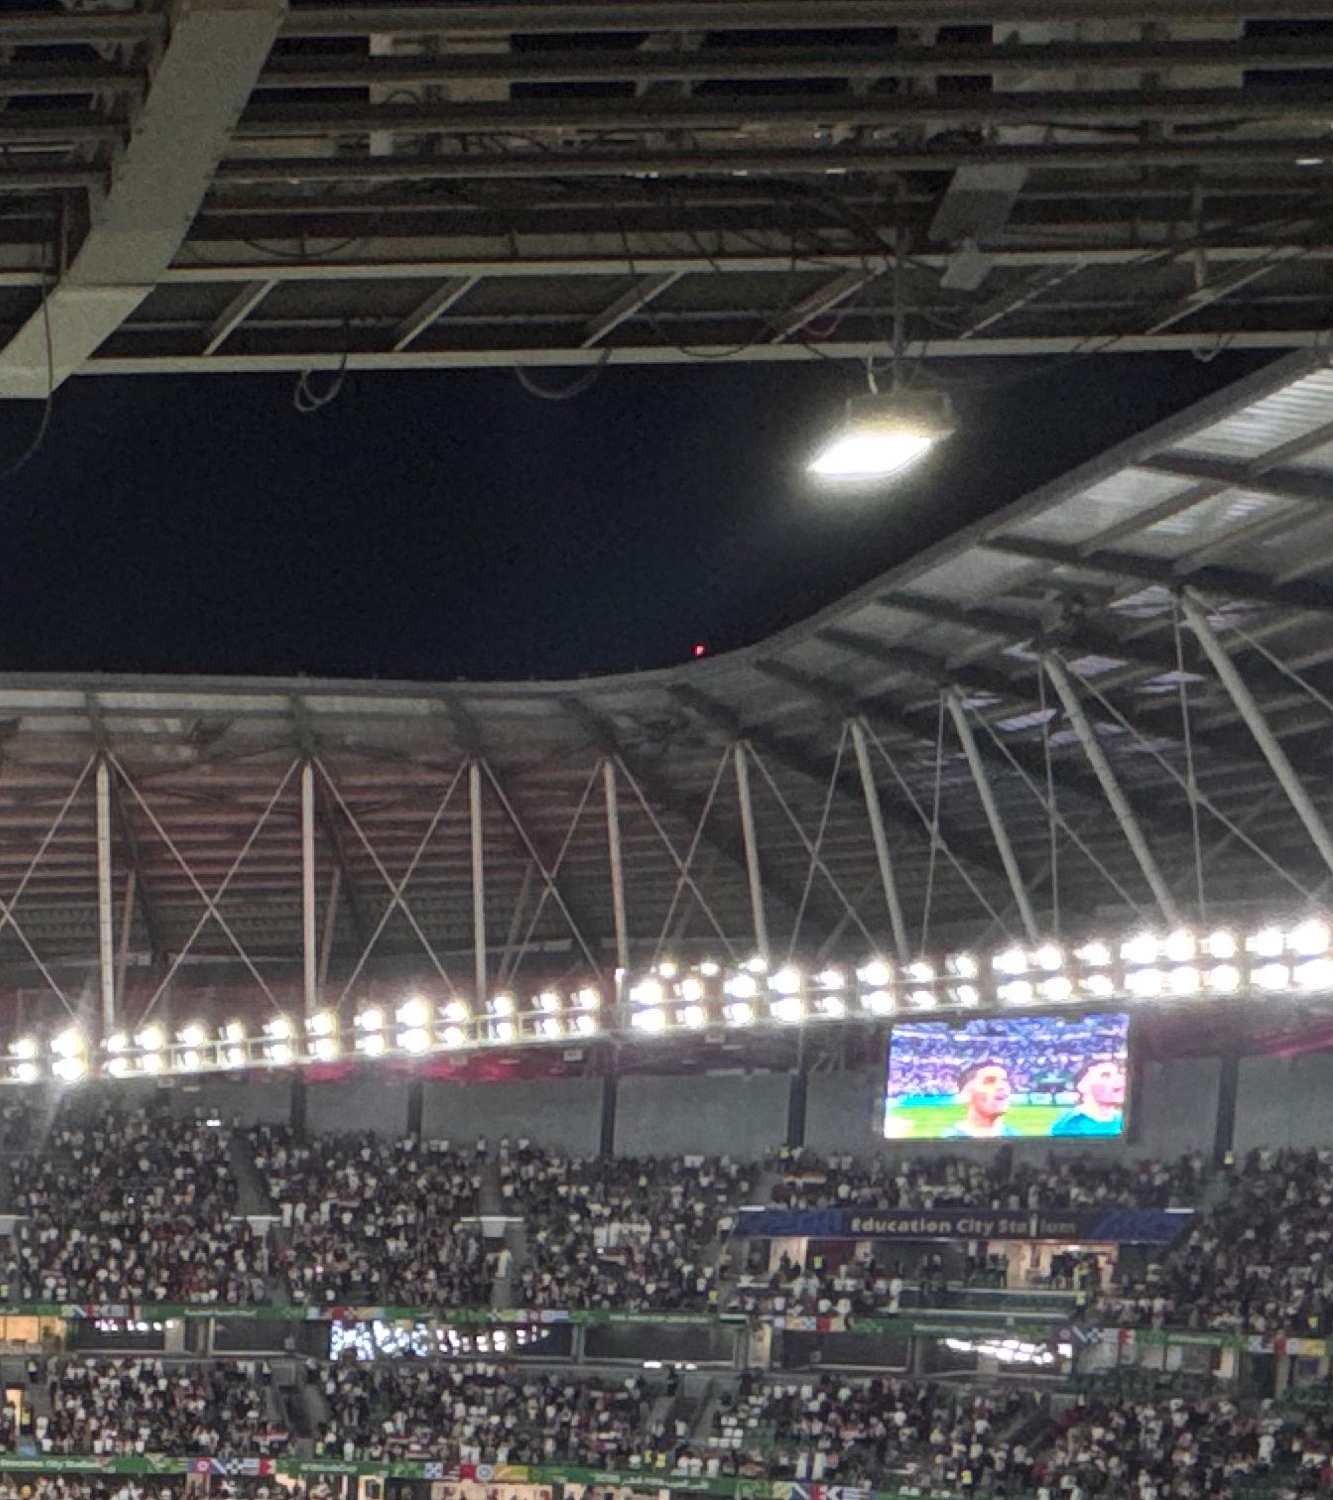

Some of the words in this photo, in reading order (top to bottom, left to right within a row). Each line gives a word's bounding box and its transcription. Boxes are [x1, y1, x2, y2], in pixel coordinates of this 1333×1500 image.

[851, 1217, 951, 1233] Education
[957, 1217, 993, 1236] City
[999, 1216, 1076, 1234] Staium
